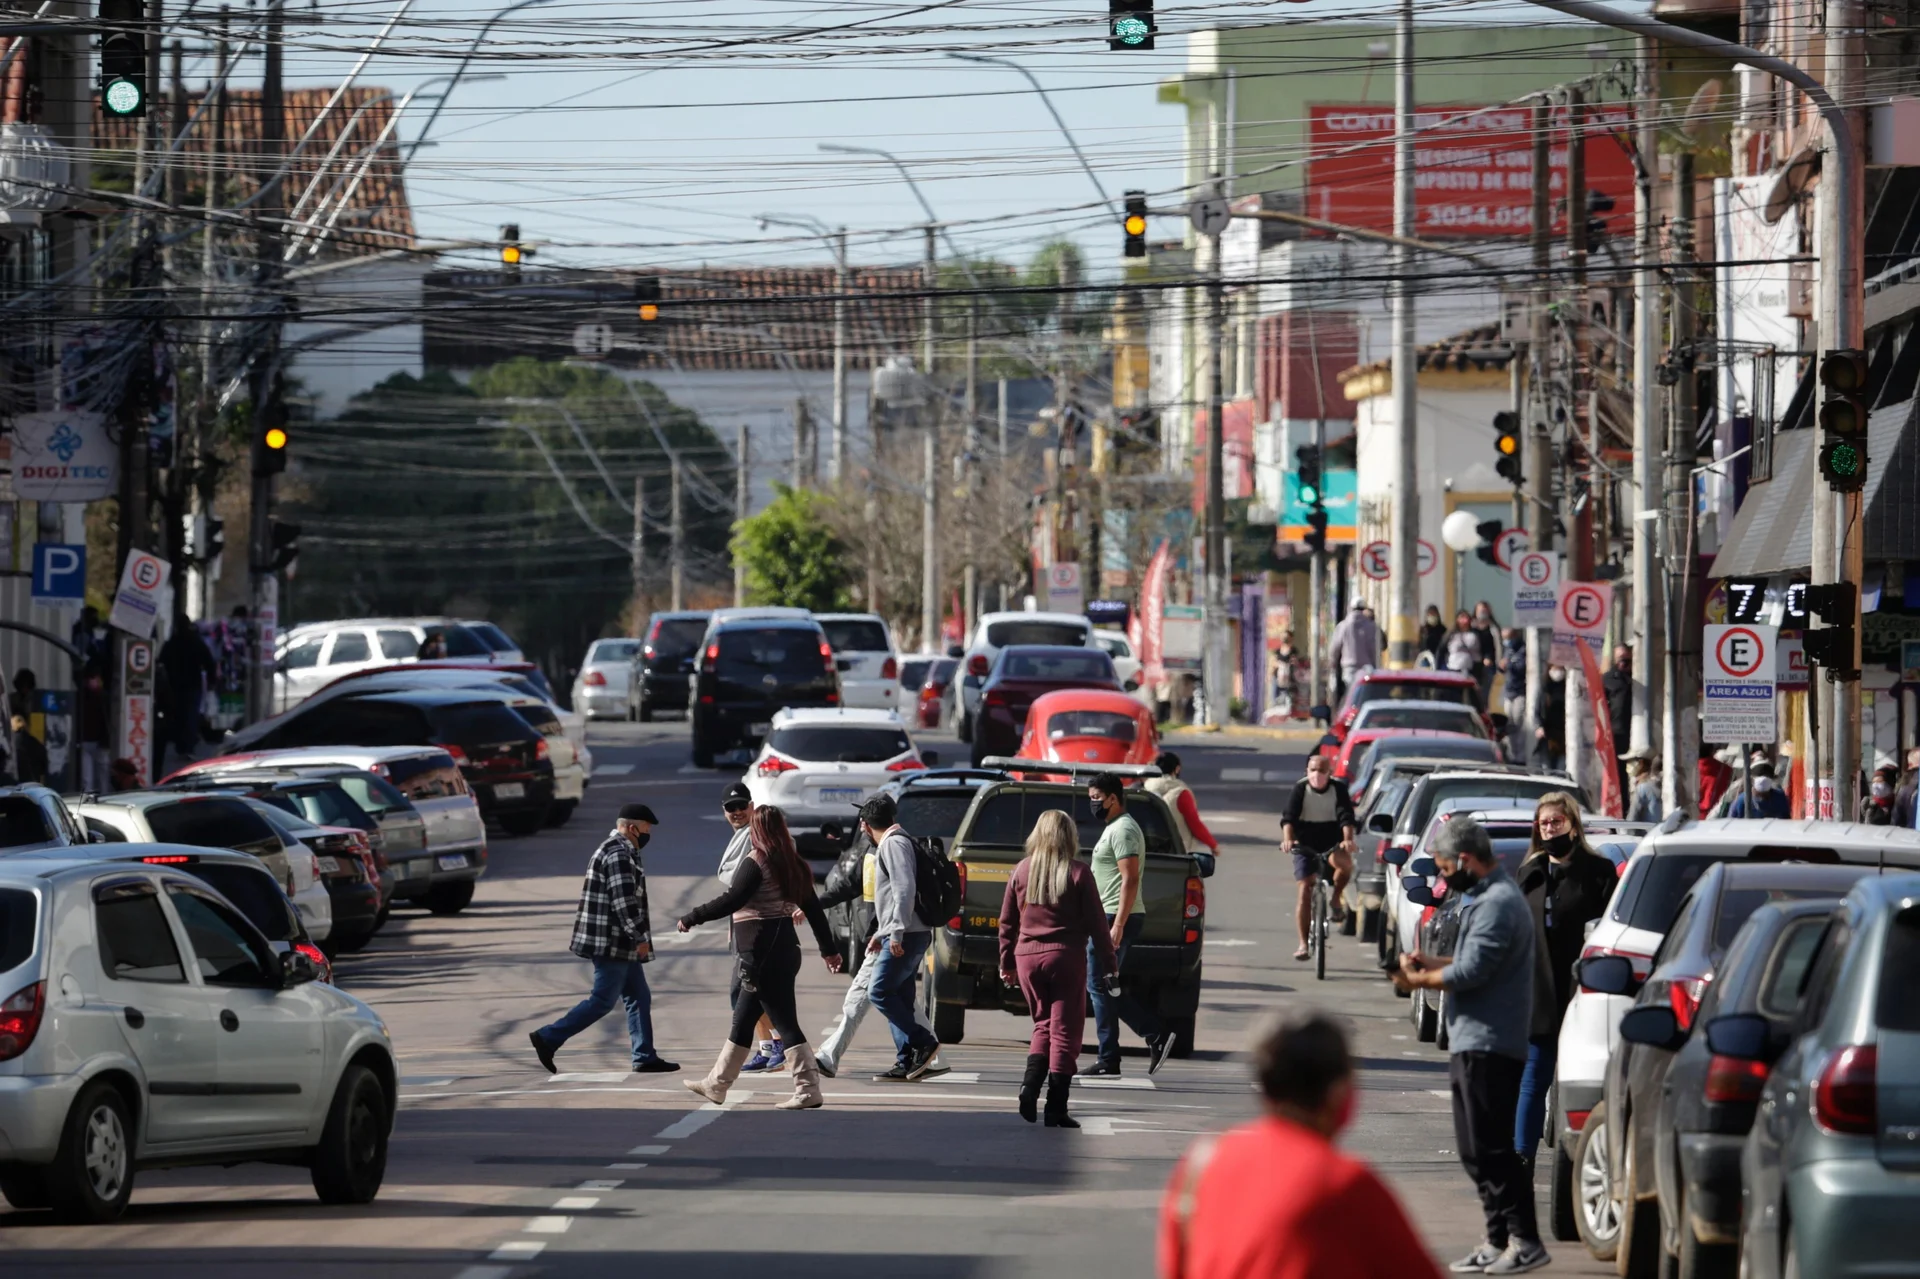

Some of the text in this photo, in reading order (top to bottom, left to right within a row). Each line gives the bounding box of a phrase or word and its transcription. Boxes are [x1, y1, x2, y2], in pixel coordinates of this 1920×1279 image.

[1414, 172, 1479, 190] MPOSTO
[22, 466, 109, 479] DIGITEC
[43, 547, 79, 592] P
[139, 563, 154, 583] E
[1528, 561, 1541, 579] E
[1517, 591, 1554, 599] MOTOS
[1575, 595, 1593, 622] E
[134, 648, 146, 667] E
[1730, 639, 1749, 666] E
[1708, 686, 1770, 696] ÁREA AZUL
